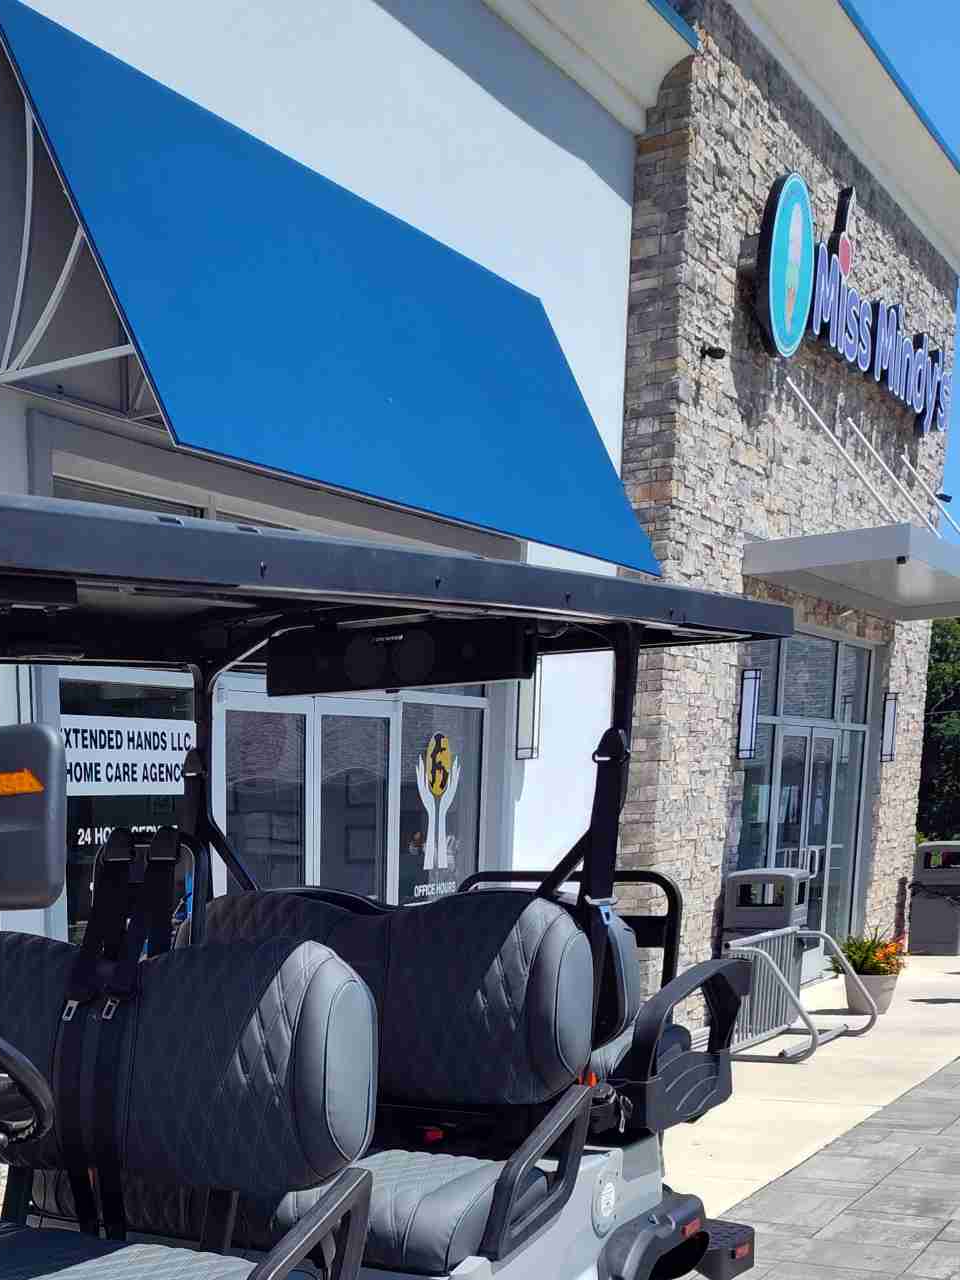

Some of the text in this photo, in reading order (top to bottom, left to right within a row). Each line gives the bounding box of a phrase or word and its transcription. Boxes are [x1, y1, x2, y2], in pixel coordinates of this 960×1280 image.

[813, 237, 873, 371] Miss
[59, 727, 192, 751] XTENDED HANDS LLC
[66, 761, 185, 783] HOME CARE AGENC
[77, 827, 92, 845] 24
[414, 881, 456, 897] OFFICE HOURS
